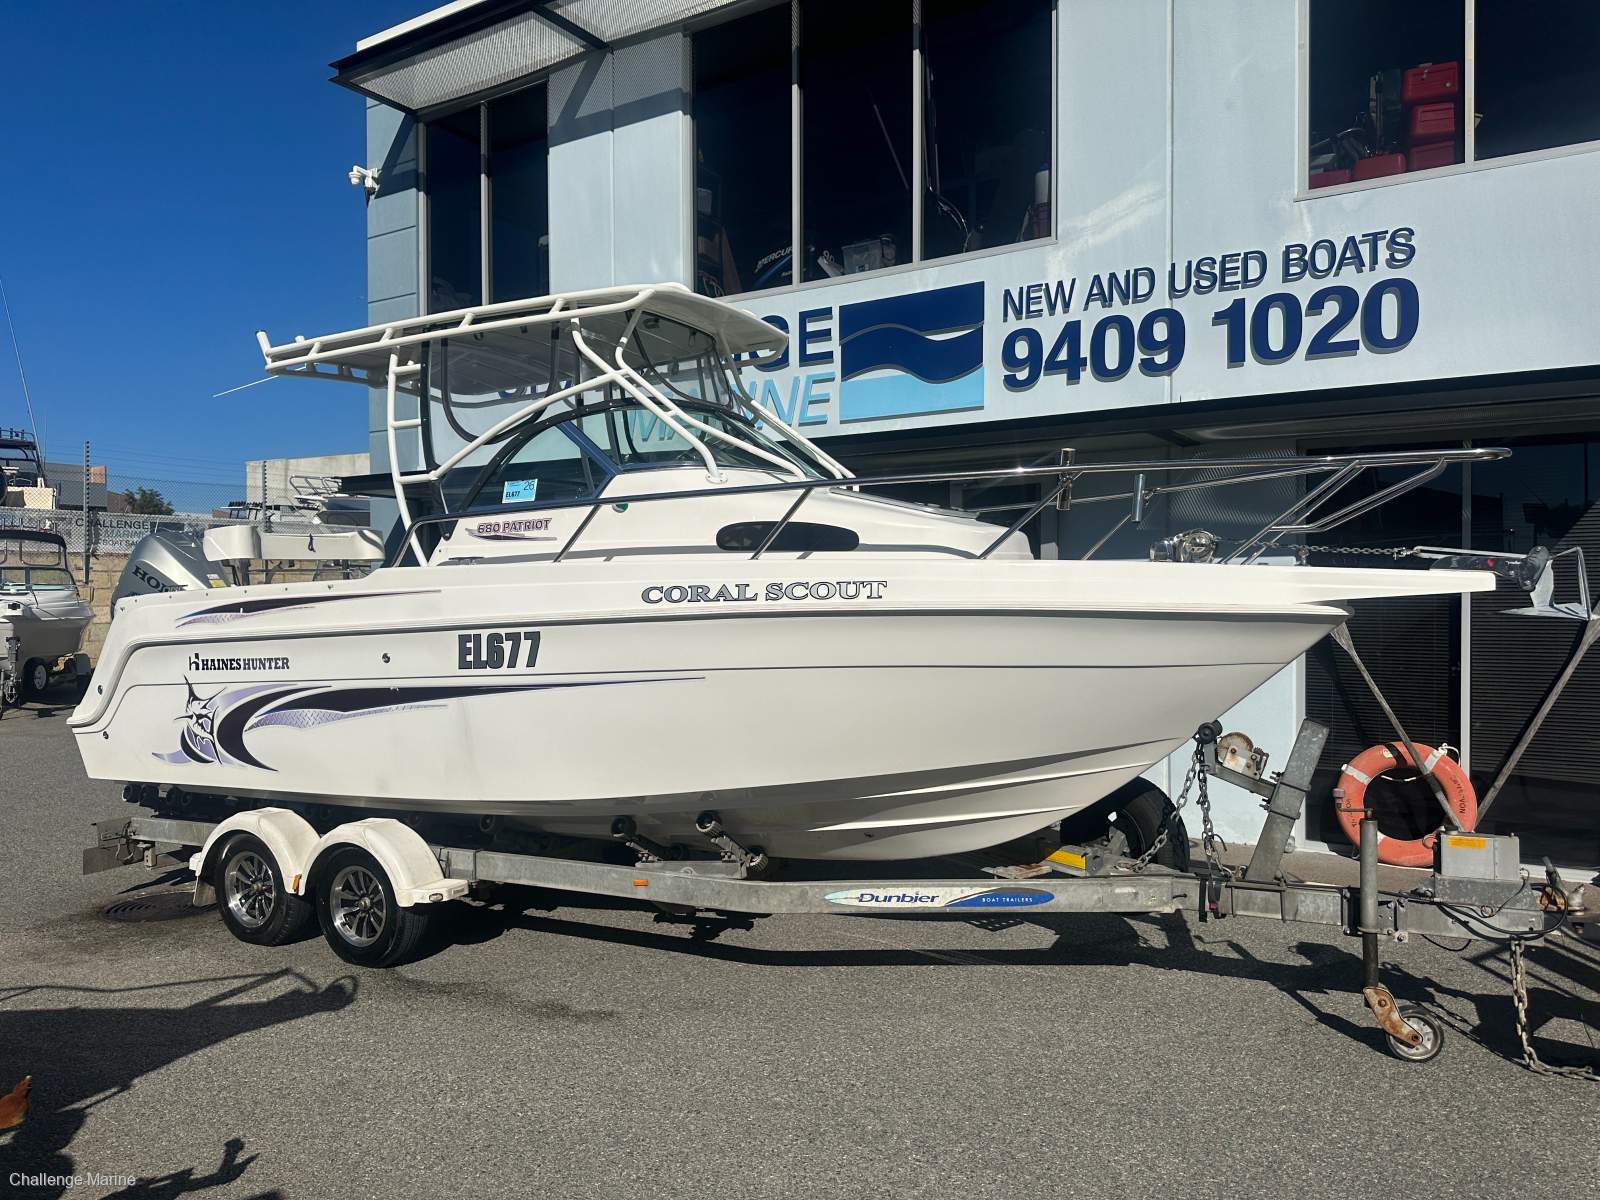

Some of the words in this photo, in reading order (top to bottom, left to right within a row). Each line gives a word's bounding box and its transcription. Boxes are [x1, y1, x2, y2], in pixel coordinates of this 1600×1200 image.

[1003, 278, 1076, 322] NEW
[1084, 266, 1156, 311] AND
[1169, 250, 1268, 299] USED
[1282, 227, 1416, 284] BOATS
[1001, 308, 1186, 393] 9409
[1211, 277, 1420, 368] 1020
[76, 518, 149, 530] CALLENGE
[478, 523, 501, 533] 680
[502, 518, 552, 533] PATRIOT
[641, 583, 758, 604] CORAL
[765, 580, 887, 601] SCOUT
[458, 631, 541, 669] EL677
[201, 658, 241, 671] HAINES
[243, 656, 290, 671] HUNTER
[858, 890, 939, 903] Dunbier
